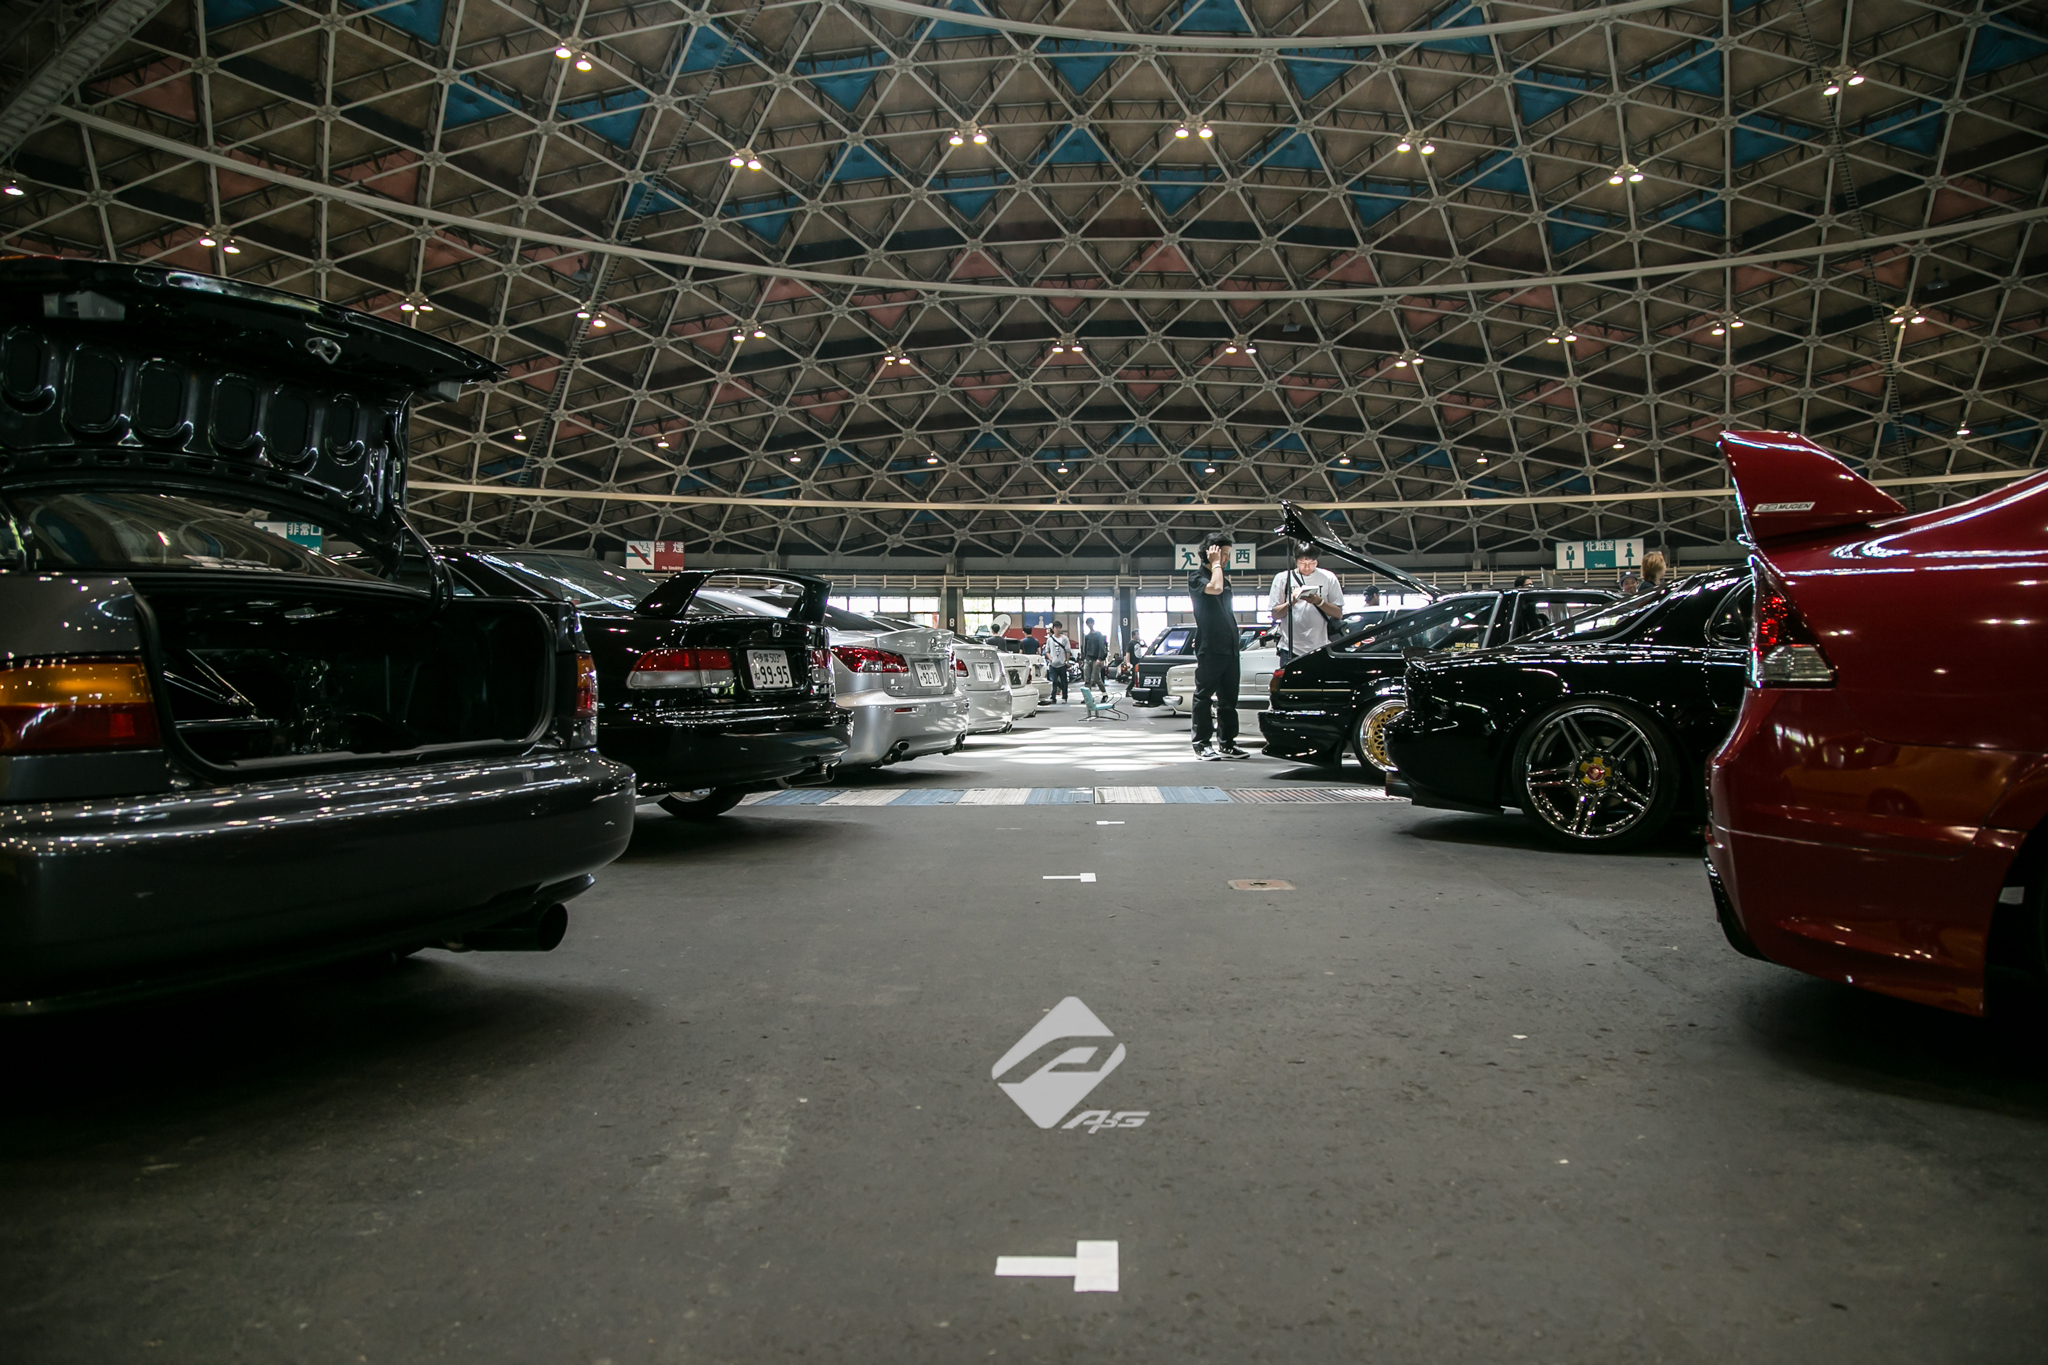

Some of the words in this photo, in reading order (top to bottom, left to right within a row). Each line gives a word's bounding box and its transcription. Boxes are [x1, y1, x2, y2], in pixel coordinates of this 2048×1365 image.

[288, 523, 321, 536] 非常口
[656, 542, 684, 553] 禁煙
[1586, 540, 1615, 552] 化粧室
[1235, 548, 1251, 564] 西
[949, 618, 955, 627] 8
[1122, 617, 1129, 627] 9
